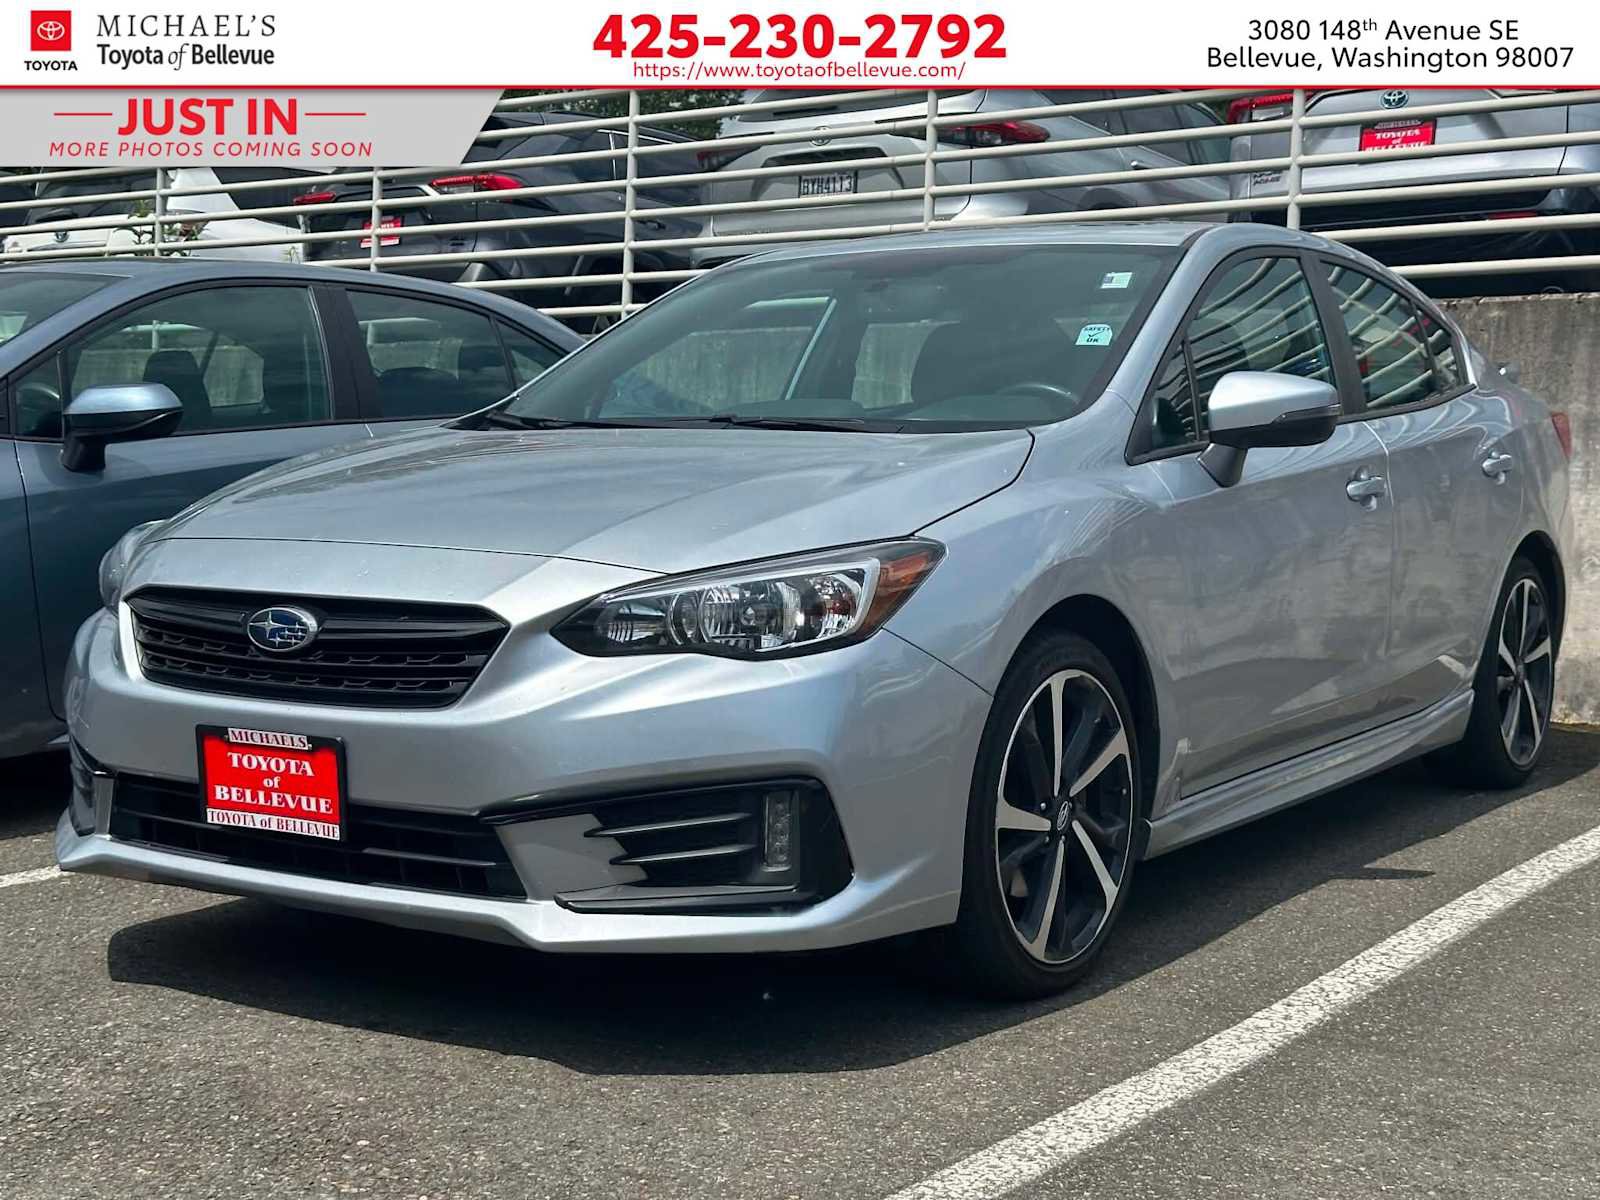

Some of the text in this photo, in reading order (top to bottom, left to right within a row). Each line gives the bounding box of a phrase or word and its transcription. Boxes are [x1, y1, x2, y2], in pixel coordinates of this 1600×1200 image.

[1375, 128, 1420, 140] TOYOTA
[230, 729, 307, 748] MICHAELS
[227, 752, 315, 777] TOYOTA
[263, 776, 280, 788] of
[214, 784, 333, 814] BELLEVUE
[208, 810, 338, 839] TOYOTA of BELLEVUE
